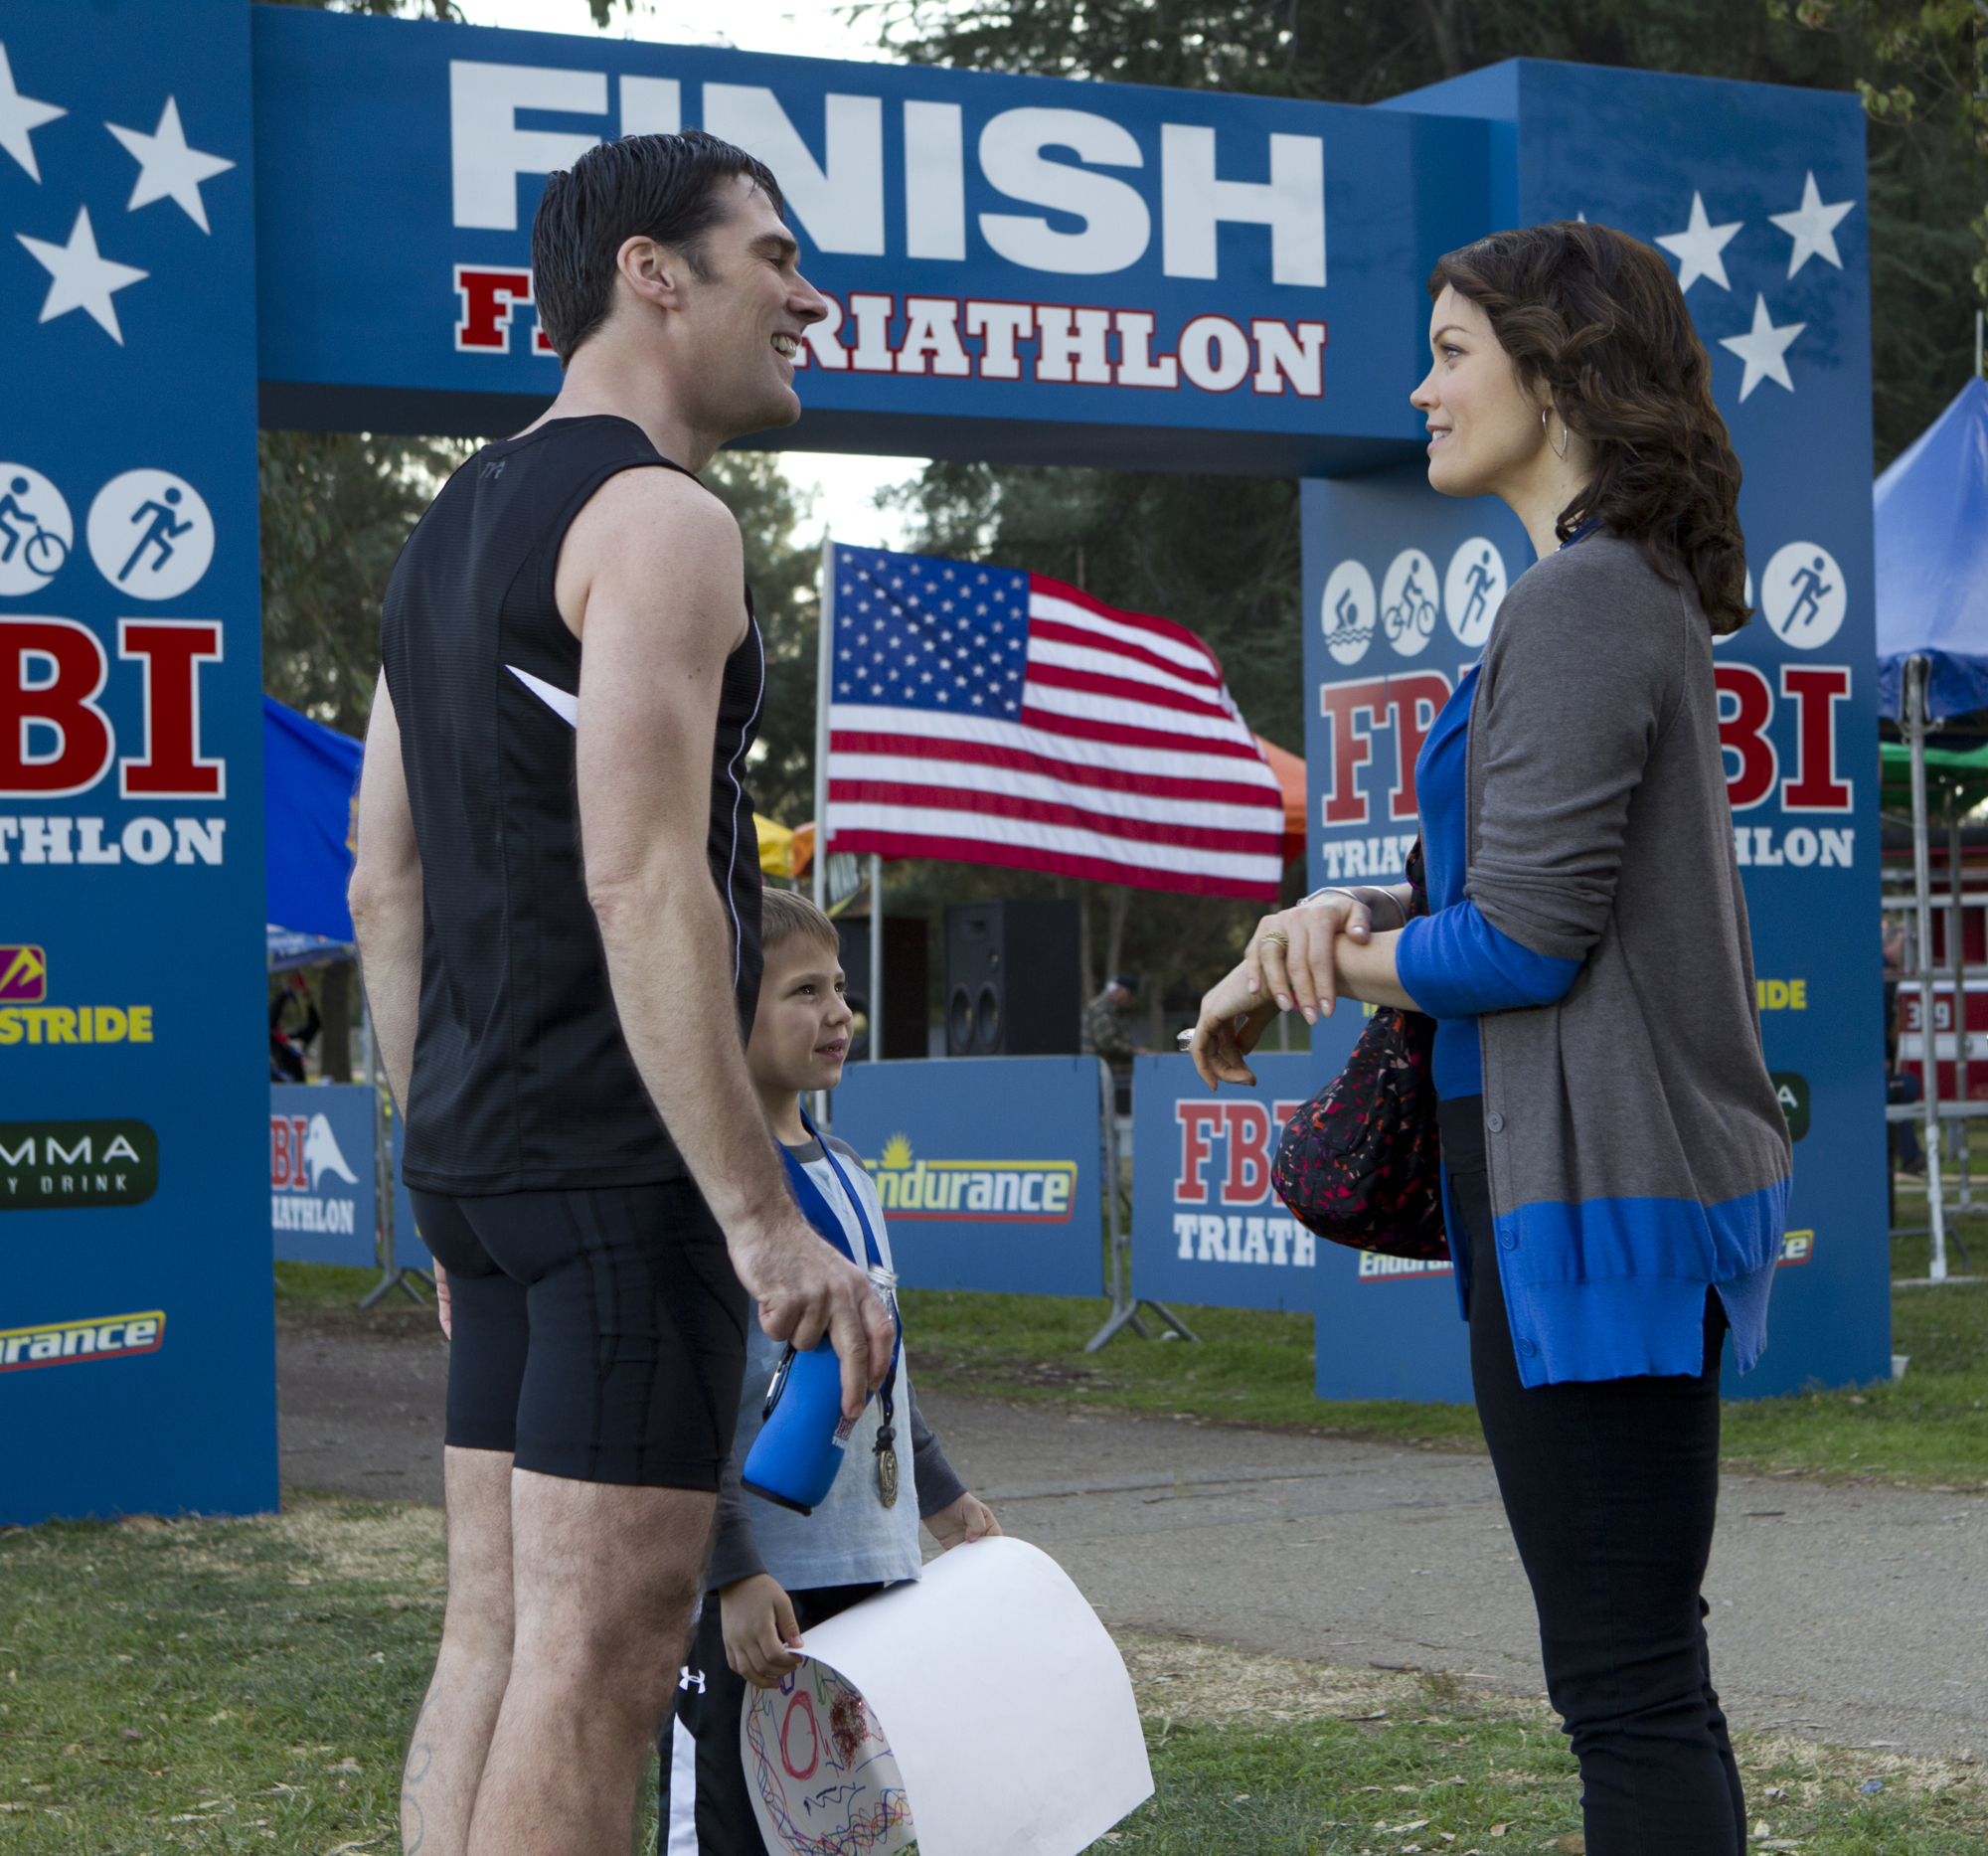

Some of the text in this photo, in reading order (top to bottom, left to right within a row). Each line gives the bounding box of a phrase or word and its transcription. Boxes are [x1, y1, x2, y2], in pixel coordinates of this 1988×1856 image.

[0, 1005, 153, 1044] STRIDE
[41, 1173, 127, 1193] DRINK
[865, 1159, 1071, 1211] ndurance
[0, 1318, 157, 1366] rance
